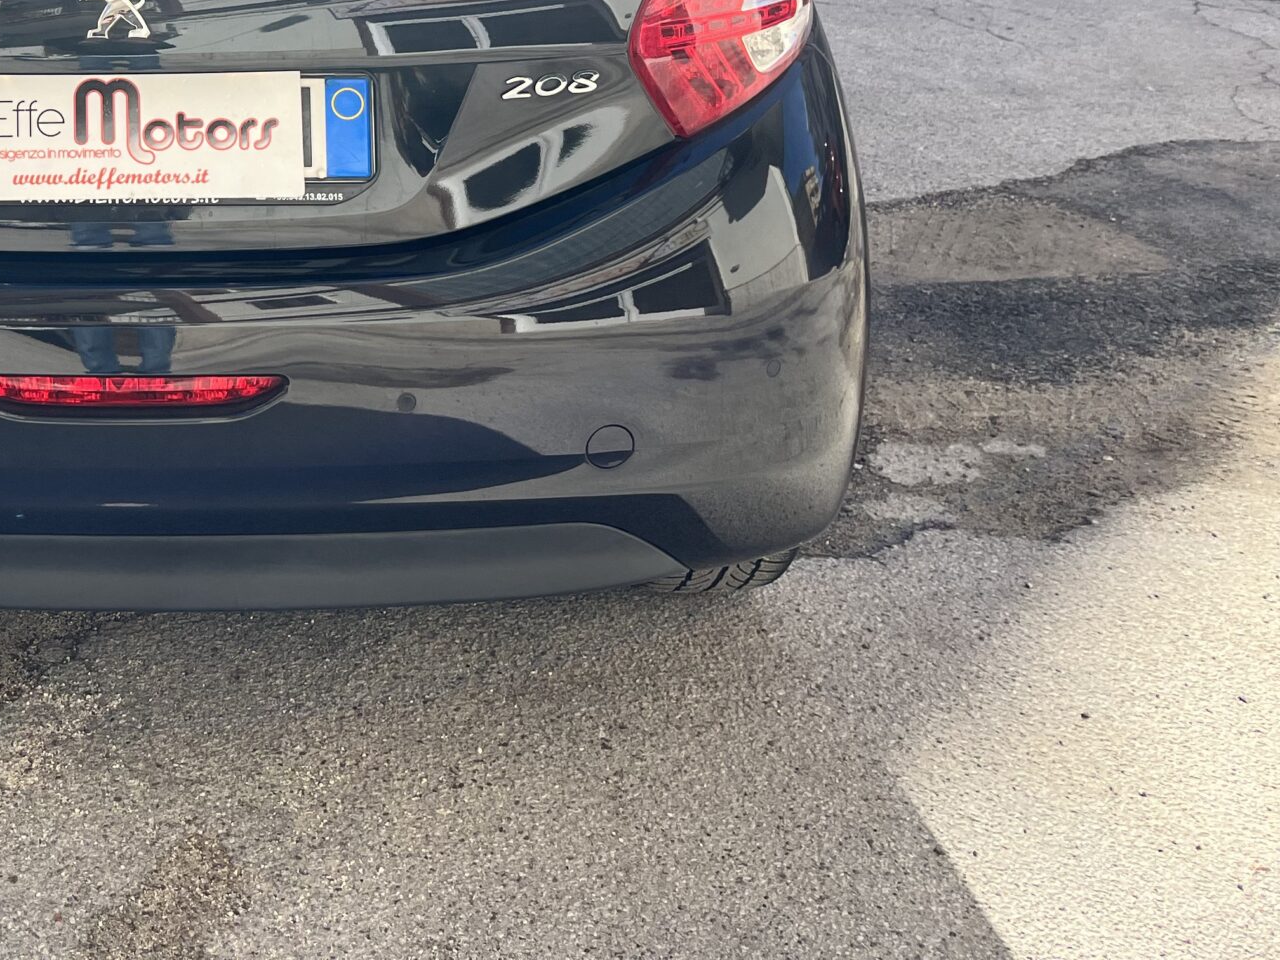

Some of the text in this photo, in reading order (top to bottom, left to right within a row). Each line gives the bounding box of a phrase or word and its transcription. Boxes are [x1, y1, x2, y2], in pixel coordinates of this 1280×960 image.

[502, 70, 600, 100] 208
[74, 78, 279, 165] Motors
[47, 147, 56, 159] in
[58, 147, 122, 159] movimento
[12, 168, 209, 190] www.dieffemotors.it
